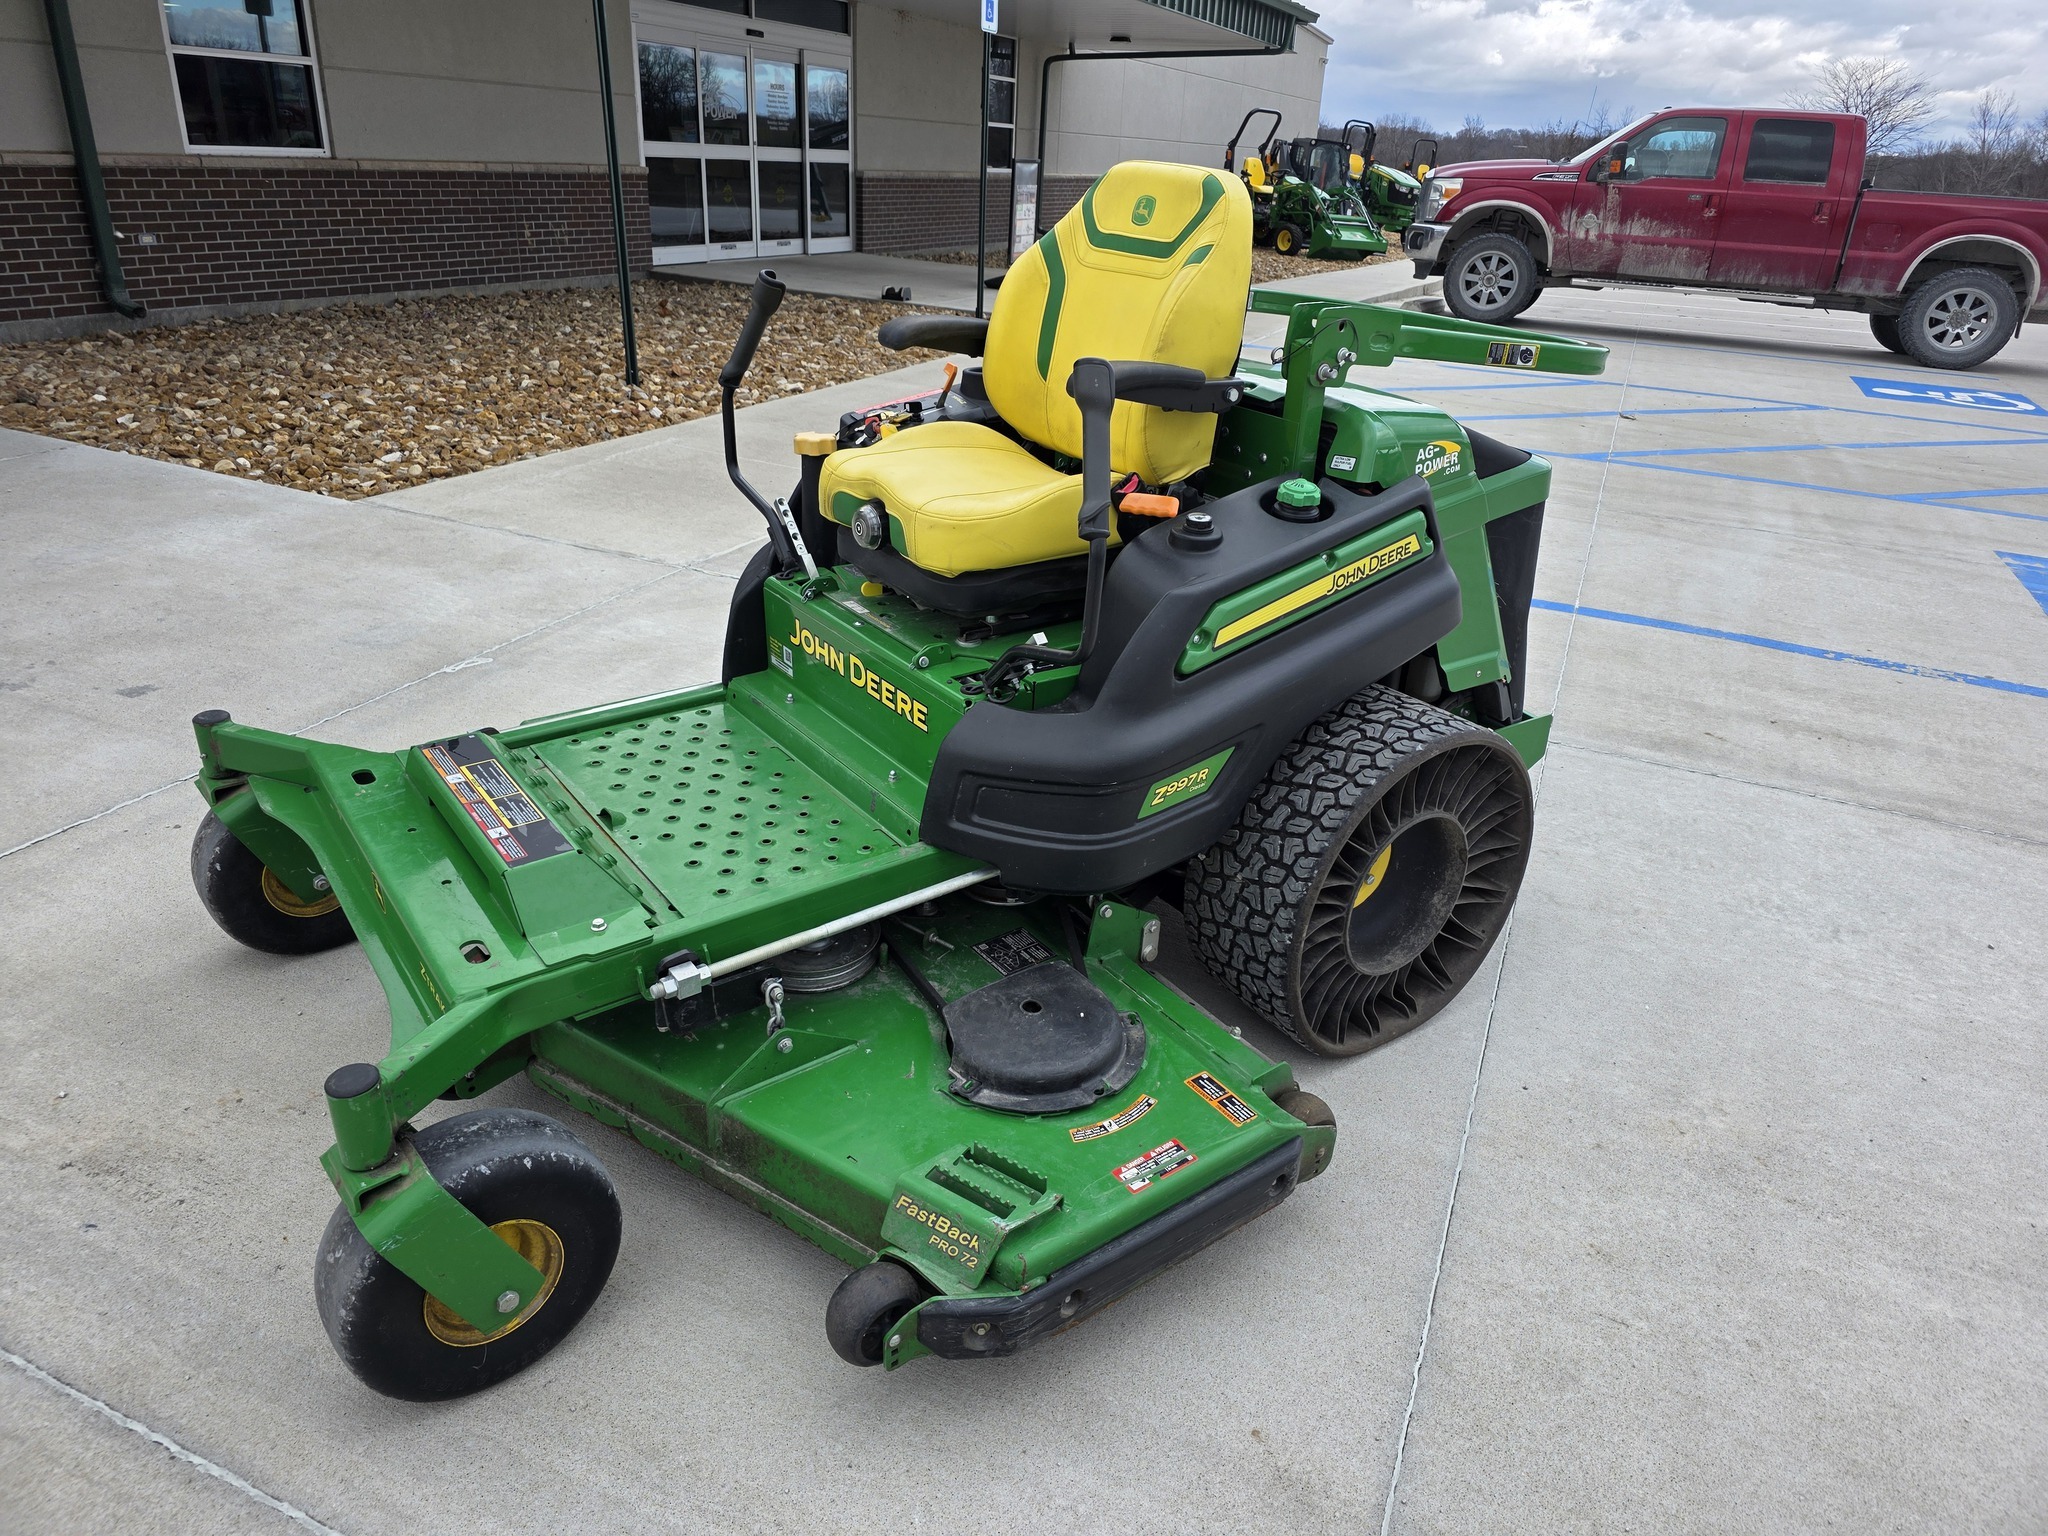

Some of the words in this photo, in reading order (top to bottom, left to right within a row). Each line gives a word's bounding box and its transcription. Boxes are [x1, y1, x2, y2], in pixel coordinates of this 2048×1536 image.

[770, 83, 785, 91] HOURS
[704, 104, 737, 119] POWER
[1414, 450, 1459, 475] POWER
[1326, 563, 1368, 597] JOHN
[1368, 540, 1412, 575] DEERE
[789, 618, 844, 677] JOHN
[848, 652, 928, 734] DEERE
[1150, 767, 1210, 807] Z997R
[1126, 1156, 1146, 1168] DANGER
[895, 1194, 980, 1252] FastBack
[928, 1234, 960, 1256] PRO
[960, 1252, 978, 1269] 72
